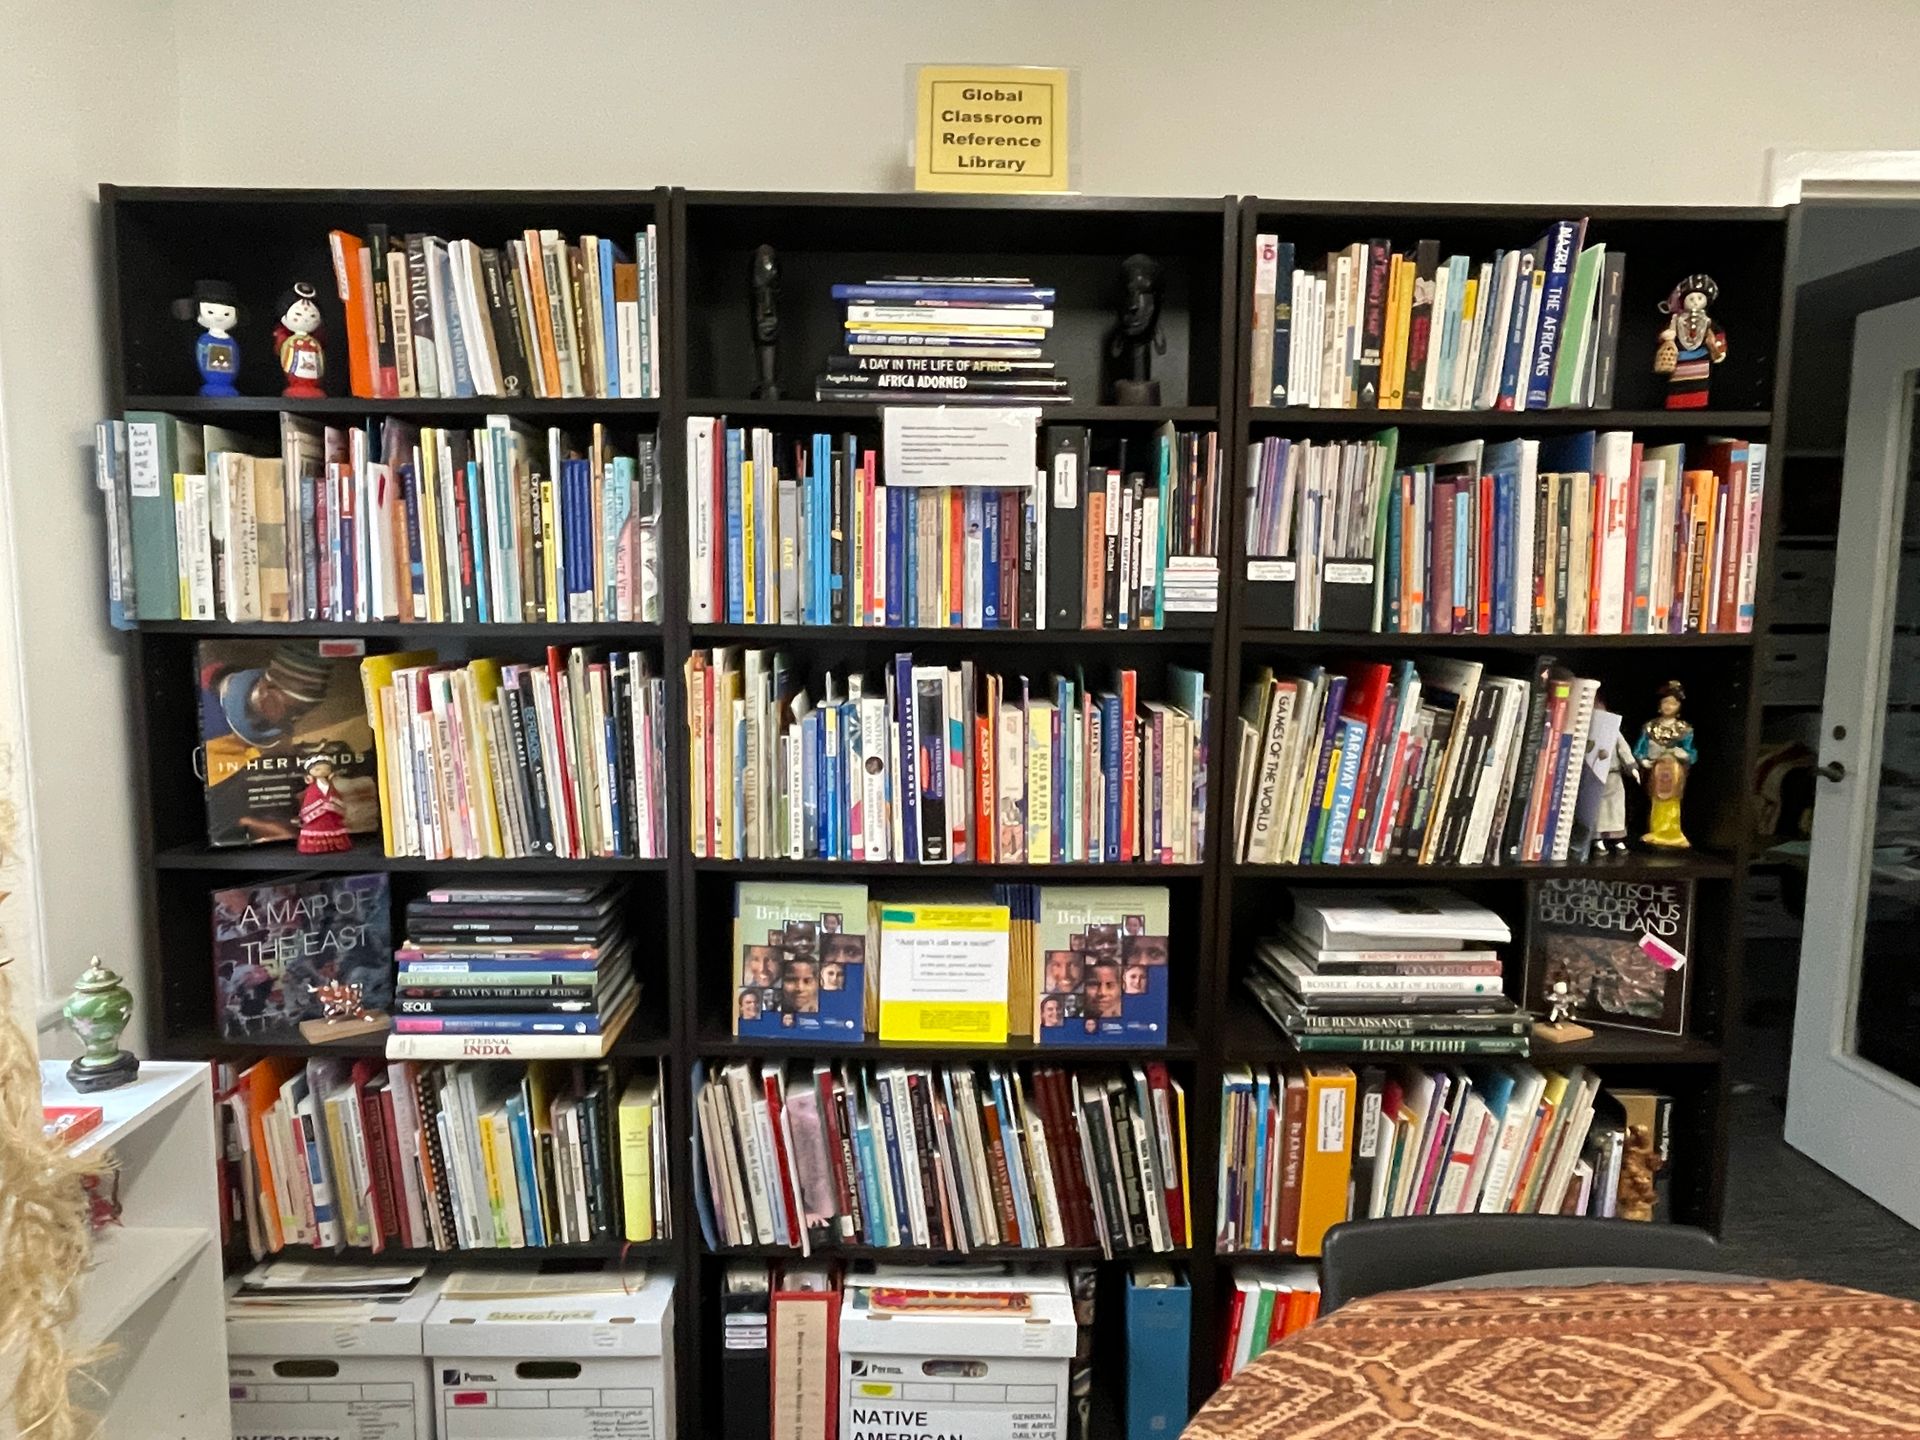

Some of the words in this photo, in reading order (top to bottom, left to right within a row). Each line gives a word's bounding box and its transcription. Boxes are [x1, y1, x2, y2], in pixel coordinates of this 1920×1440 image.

[962, 88, 1022, 102] Global
[941, 110, 1042, 125] Classroom
[942, 133, 1041, 147] Reference
[958, 156, 1026, 172] Library
[1551, 227, 1573, 273] MAZRUI
[409, 250, 430, 322] AFRICA
[1546, 287, 1563, 311] THE
[1535, 316, 1554, 376] AFRICANS
[860, 359, 870, 369] A
[870, 360, 890, 370] DAY
[893, 360, 903, 370] IN
[907, 360, 927, 371] THE
[931, 360, 953, 371] LIFE
[956, 361, 970, 371] OF
[972, 361, 1012, 372] AFRICA
[878, 375, 915, 387] AFRICA
[917, 376, 967, 389] ADORNED
[1132, 508, 1142, 536] White
[783, 537, 793, 570] RACE
[1092, 496, 1101, 589] TRUSTBUILDING
[1107, 537, 1115, 571] RACISM
[1131, 537, 1140, 590] Awareness
[747, 695, 756, 714] WE
[1271, 696, 1290, 740] GAMES
[438, 720, 449, 750] Hands
[509, 692, 521, 728] WORLD
[515, 731, 527, 767] CRAFTS
[695, 715, 703, 739] mine
[747, 717, 756, 737] ARE
[873, 705, 882, 755] JONATHAN
[1109, 700, 1120, 752] CELEBRATING
[218, 762, 239, 773] IN
[247, 758, 288, 771] HER
[297, 753, 366, 767] HNDS
[443, 754, 451, 767] On
[747, 743, 756, 761] THE
[1123, 719, 1133, 781] FRENCH
[1270, 741, 1281, 758] OF
[1341, 727, 1364, 790] FARAWAY
[1039, 752, 1047, 821] RUSSIAN
[1109, 767, 1118, 803] EQUALITY
[1265, 762, 1279, 784] THE
[445, 771, 456, 811] Heritage
[747, 768, 756, 825] CHILDREN
[982, 774, 991, 816] FABLES
[1256, 786, 1275, 832] WORLD
[1331, 795, 1351, 842] PLACES
[240, 905, 261, 929] A
[267, 895, 329, 924] MAP
[335, 888, 372, 915] OF
[756, 905, 812, 924] Bridges
[1057, 910, 1115, 929] Bridges
[1539, 889, 1638, 916] FLUGBILDER
[1644, 903, 1680, 921] AUS
[1540, 905, 1677, 936] DEUTSCHLAND
[240, 936, 297, 966] THE
[304, 923, 372, 956] EAST
[1386, 981, 1405, 989] ART
[1426, 982, 1463, 990] EUROPE
[402, 1002, 433, 1012] SEOUL
[1305, 1017, 1330, 1027] THE
[1332, 1016, 1414, 1029] RENAISSANCE
[463, 1046, 511, 1055] INDIA
[747, 1138, 755, 1157] Tales
[751, 1166, 762, 1195] Legends
[842, 1139, 854, 1185] DAUGHTERS
[849, 1186, 855, 1194] OF
[488, 1311, 595, 1322] Stereotypes
[464, 1372, 497, 1383] Perma.
[871, 1365, 903, 1374] Perma.
[853, 1409, 928, 1426] NATIVE
